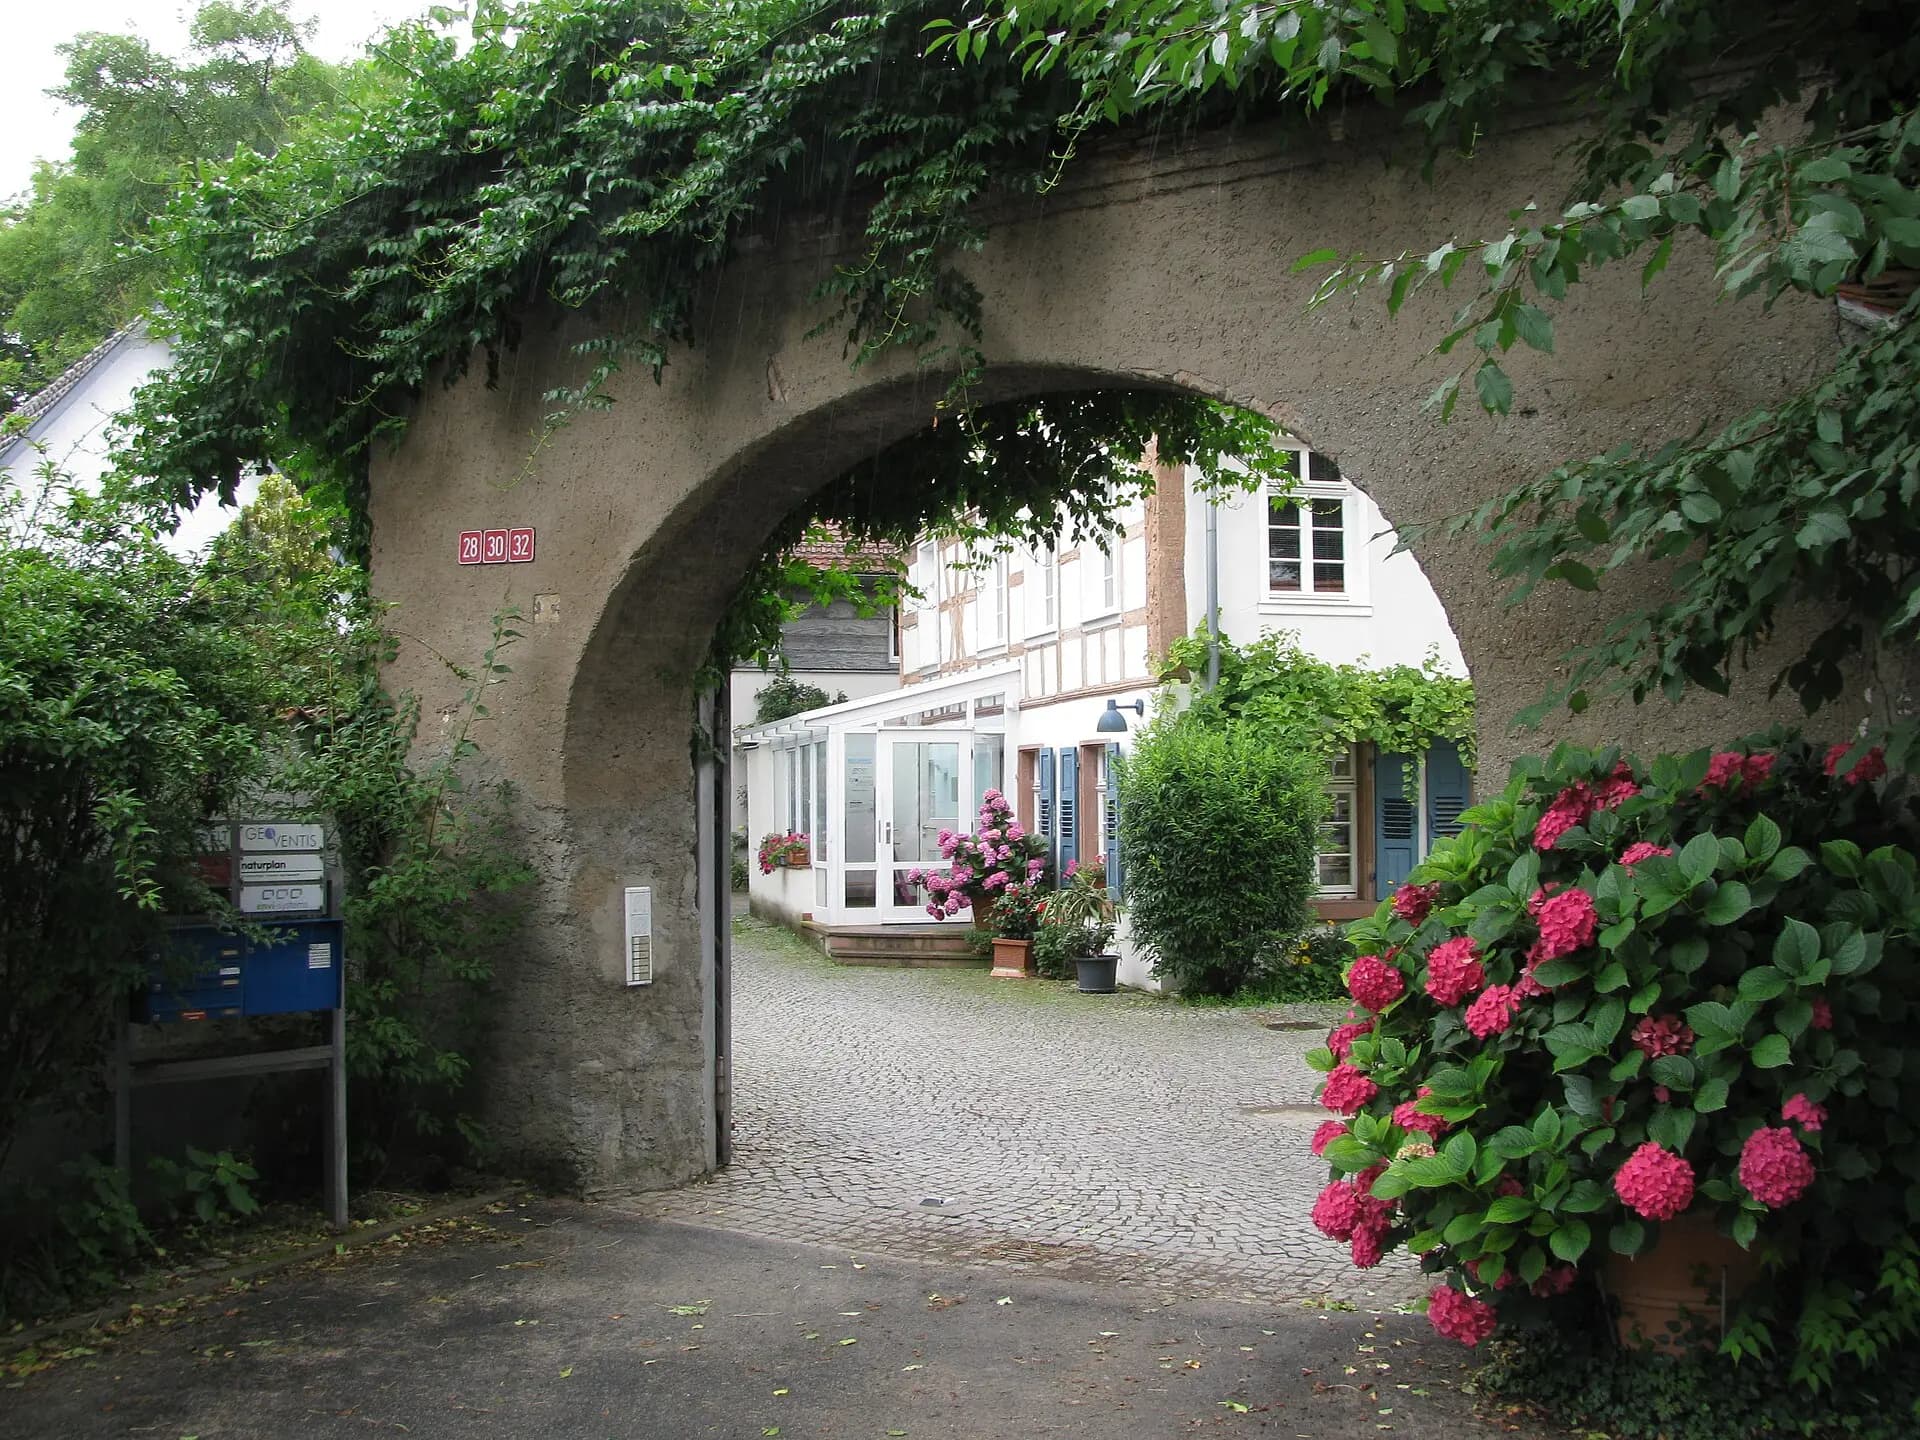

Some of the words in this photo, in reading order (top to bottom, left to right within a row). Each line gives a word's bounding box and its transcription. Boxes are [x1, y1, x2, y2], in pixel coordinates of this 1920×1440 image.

[463, 537, 478, 558] 28
[487, 535, 504, 557] 30
[513, 534, 529, 556] 32
[241, 860, 286, 870] naturplan
